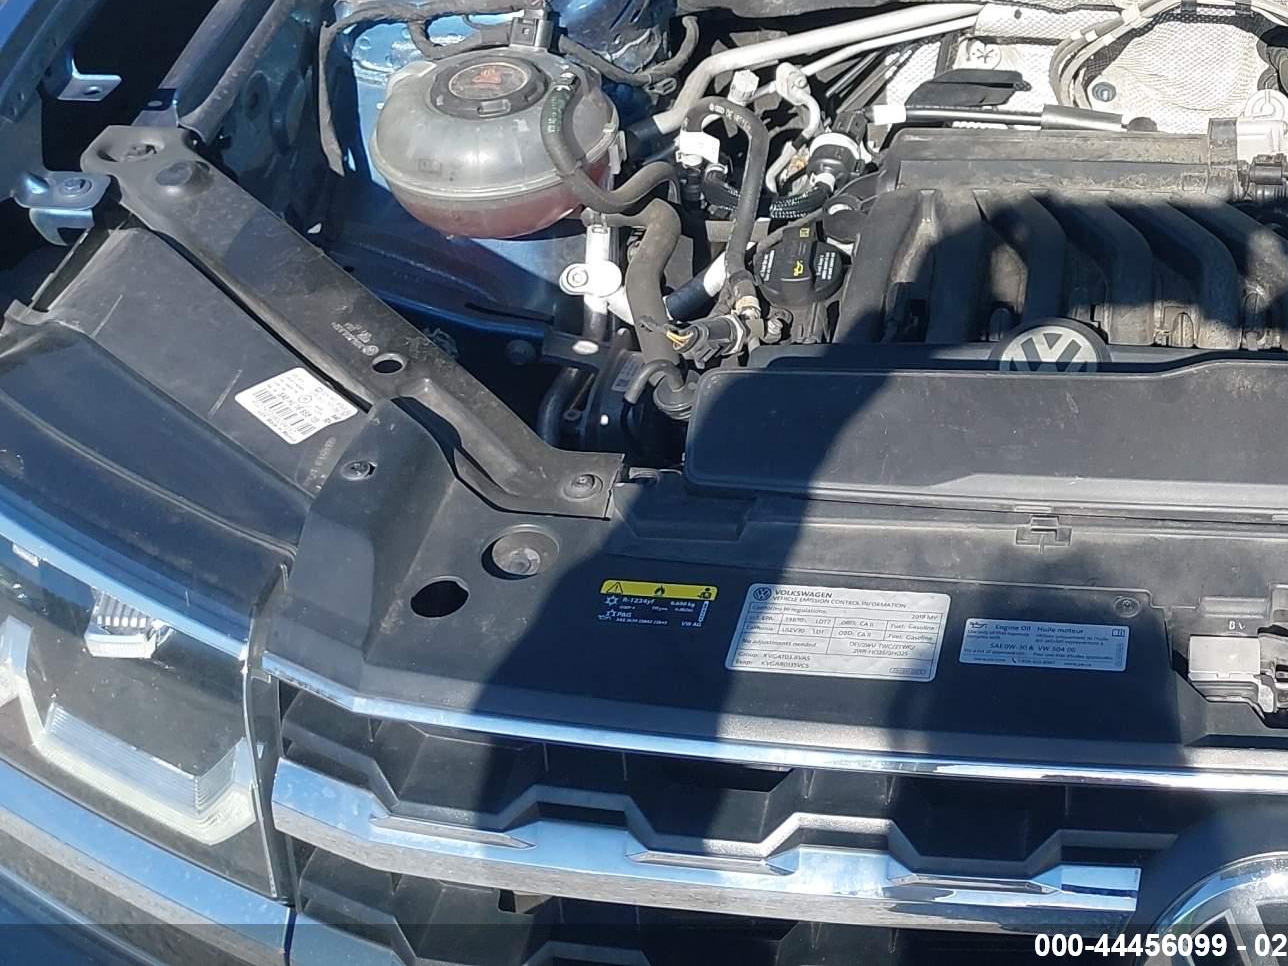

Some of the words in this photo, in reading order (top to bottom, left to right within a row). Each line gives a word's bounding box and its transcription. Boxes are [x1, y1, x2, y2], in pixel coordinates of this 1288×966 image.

[774, 589, 833, 599] VOLKSWAGEN
[799, 597, 830, 605] EMISSION
[861, 601, 907, 609] INFORMATION
[995, 624, 1020, 632] Engine
